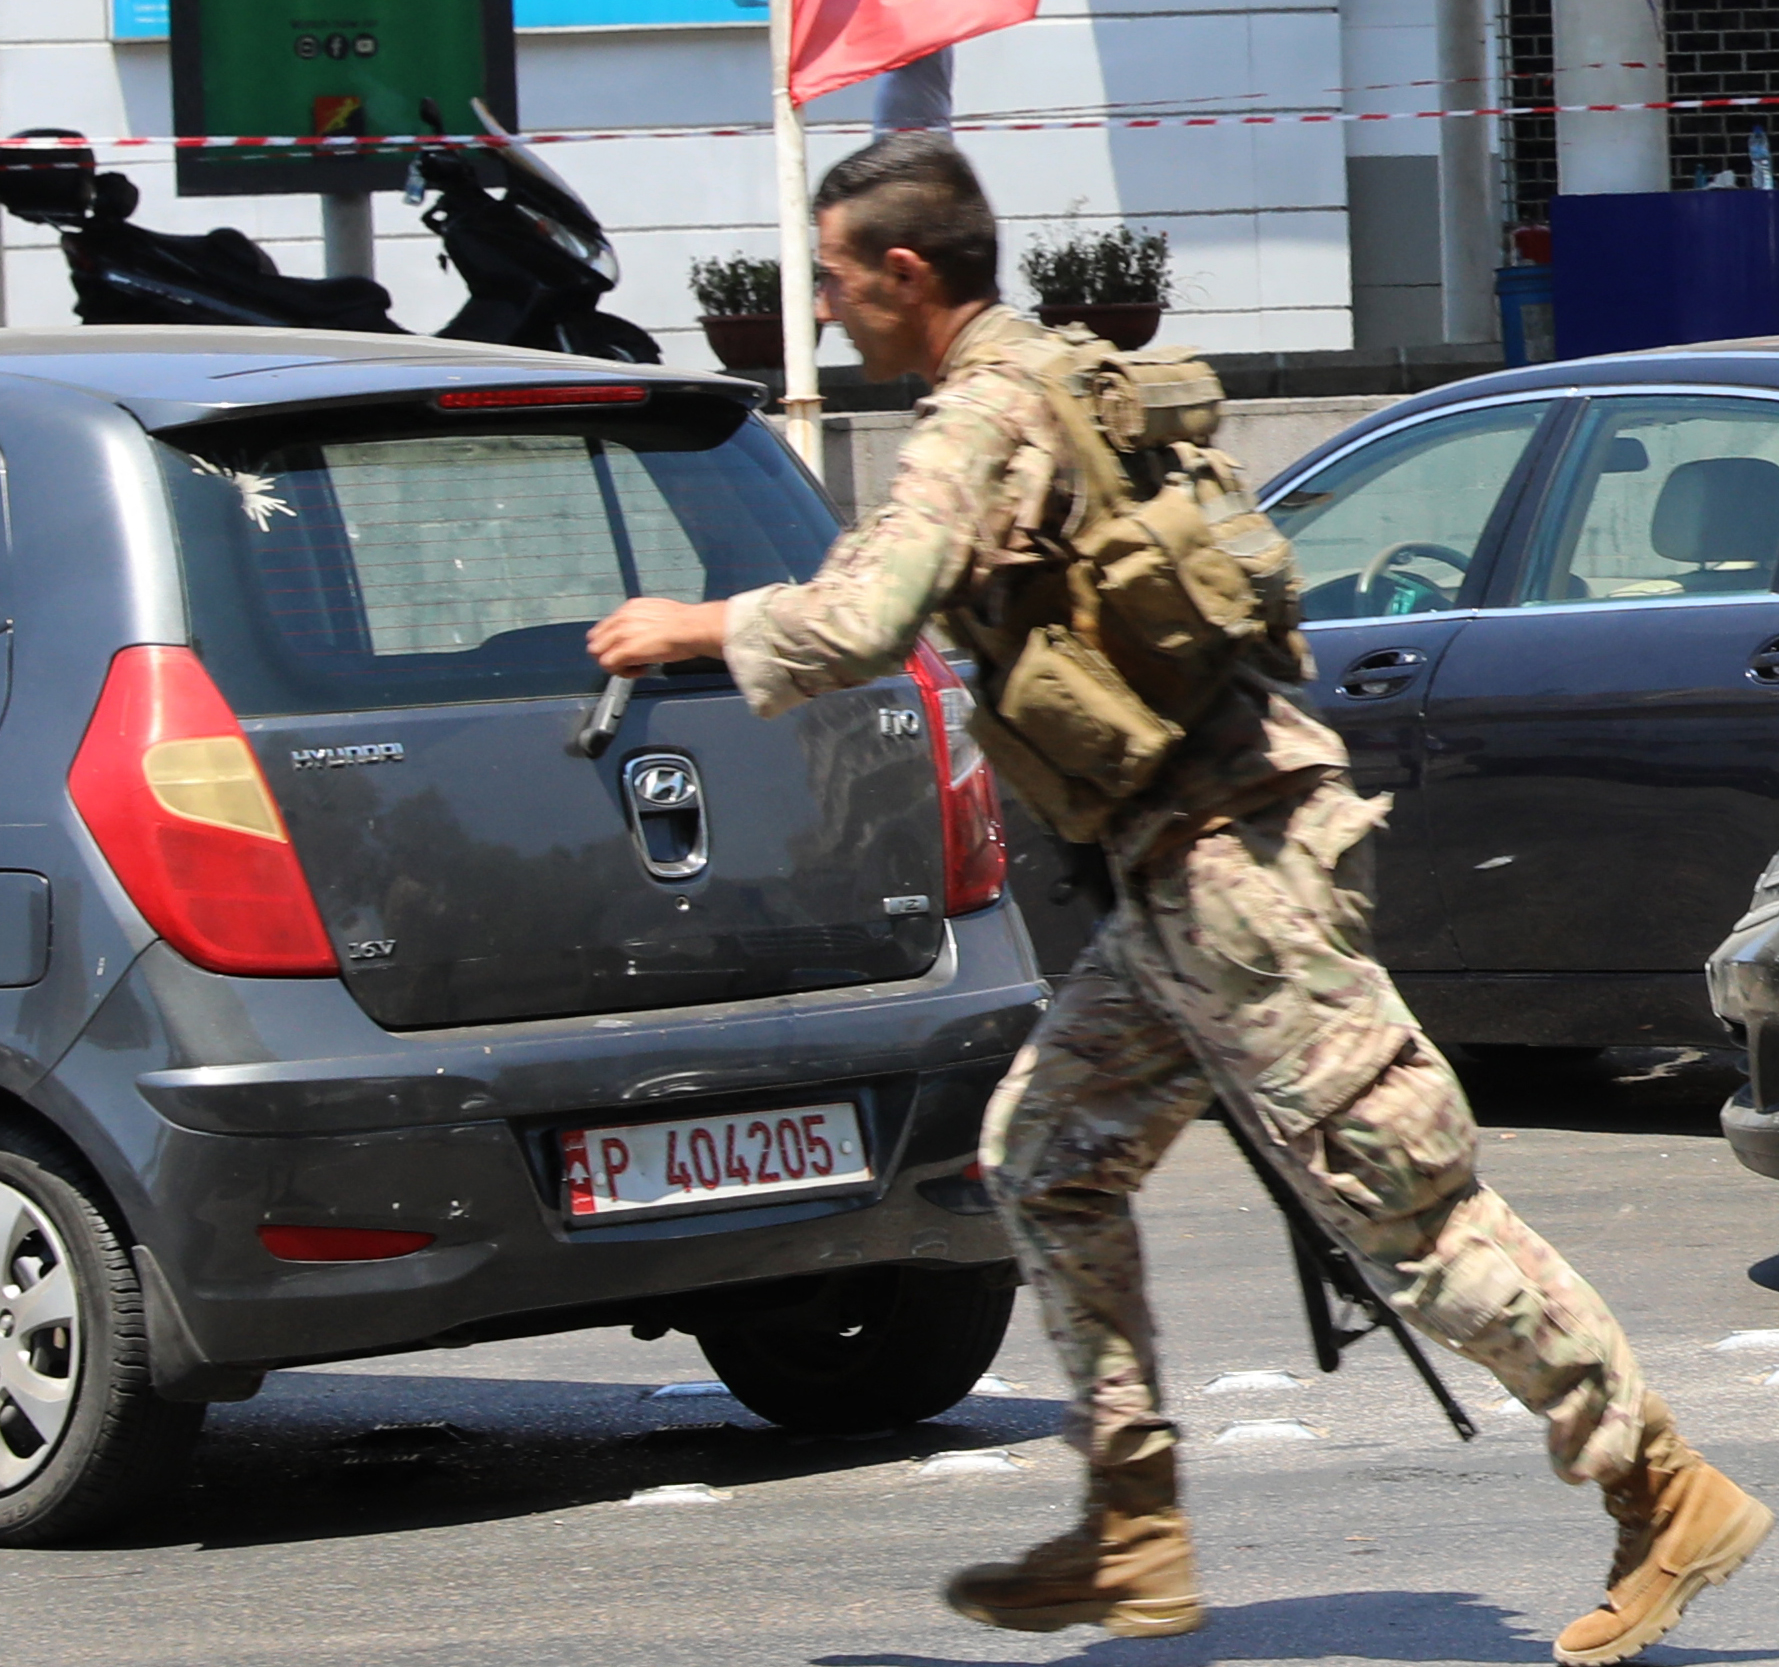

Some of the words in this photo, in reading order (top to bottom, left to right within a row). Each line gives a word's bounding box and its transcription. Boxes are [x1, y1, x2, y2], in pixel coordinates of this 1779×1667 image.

[878, 707, 920, 736] i10
[290, 742, 404, 770] HYUNDAI
[348, 939, 397, 959] 16V
[601, 1136, 630, 1202] P
[665, 1114, 834, 1193] 404205
